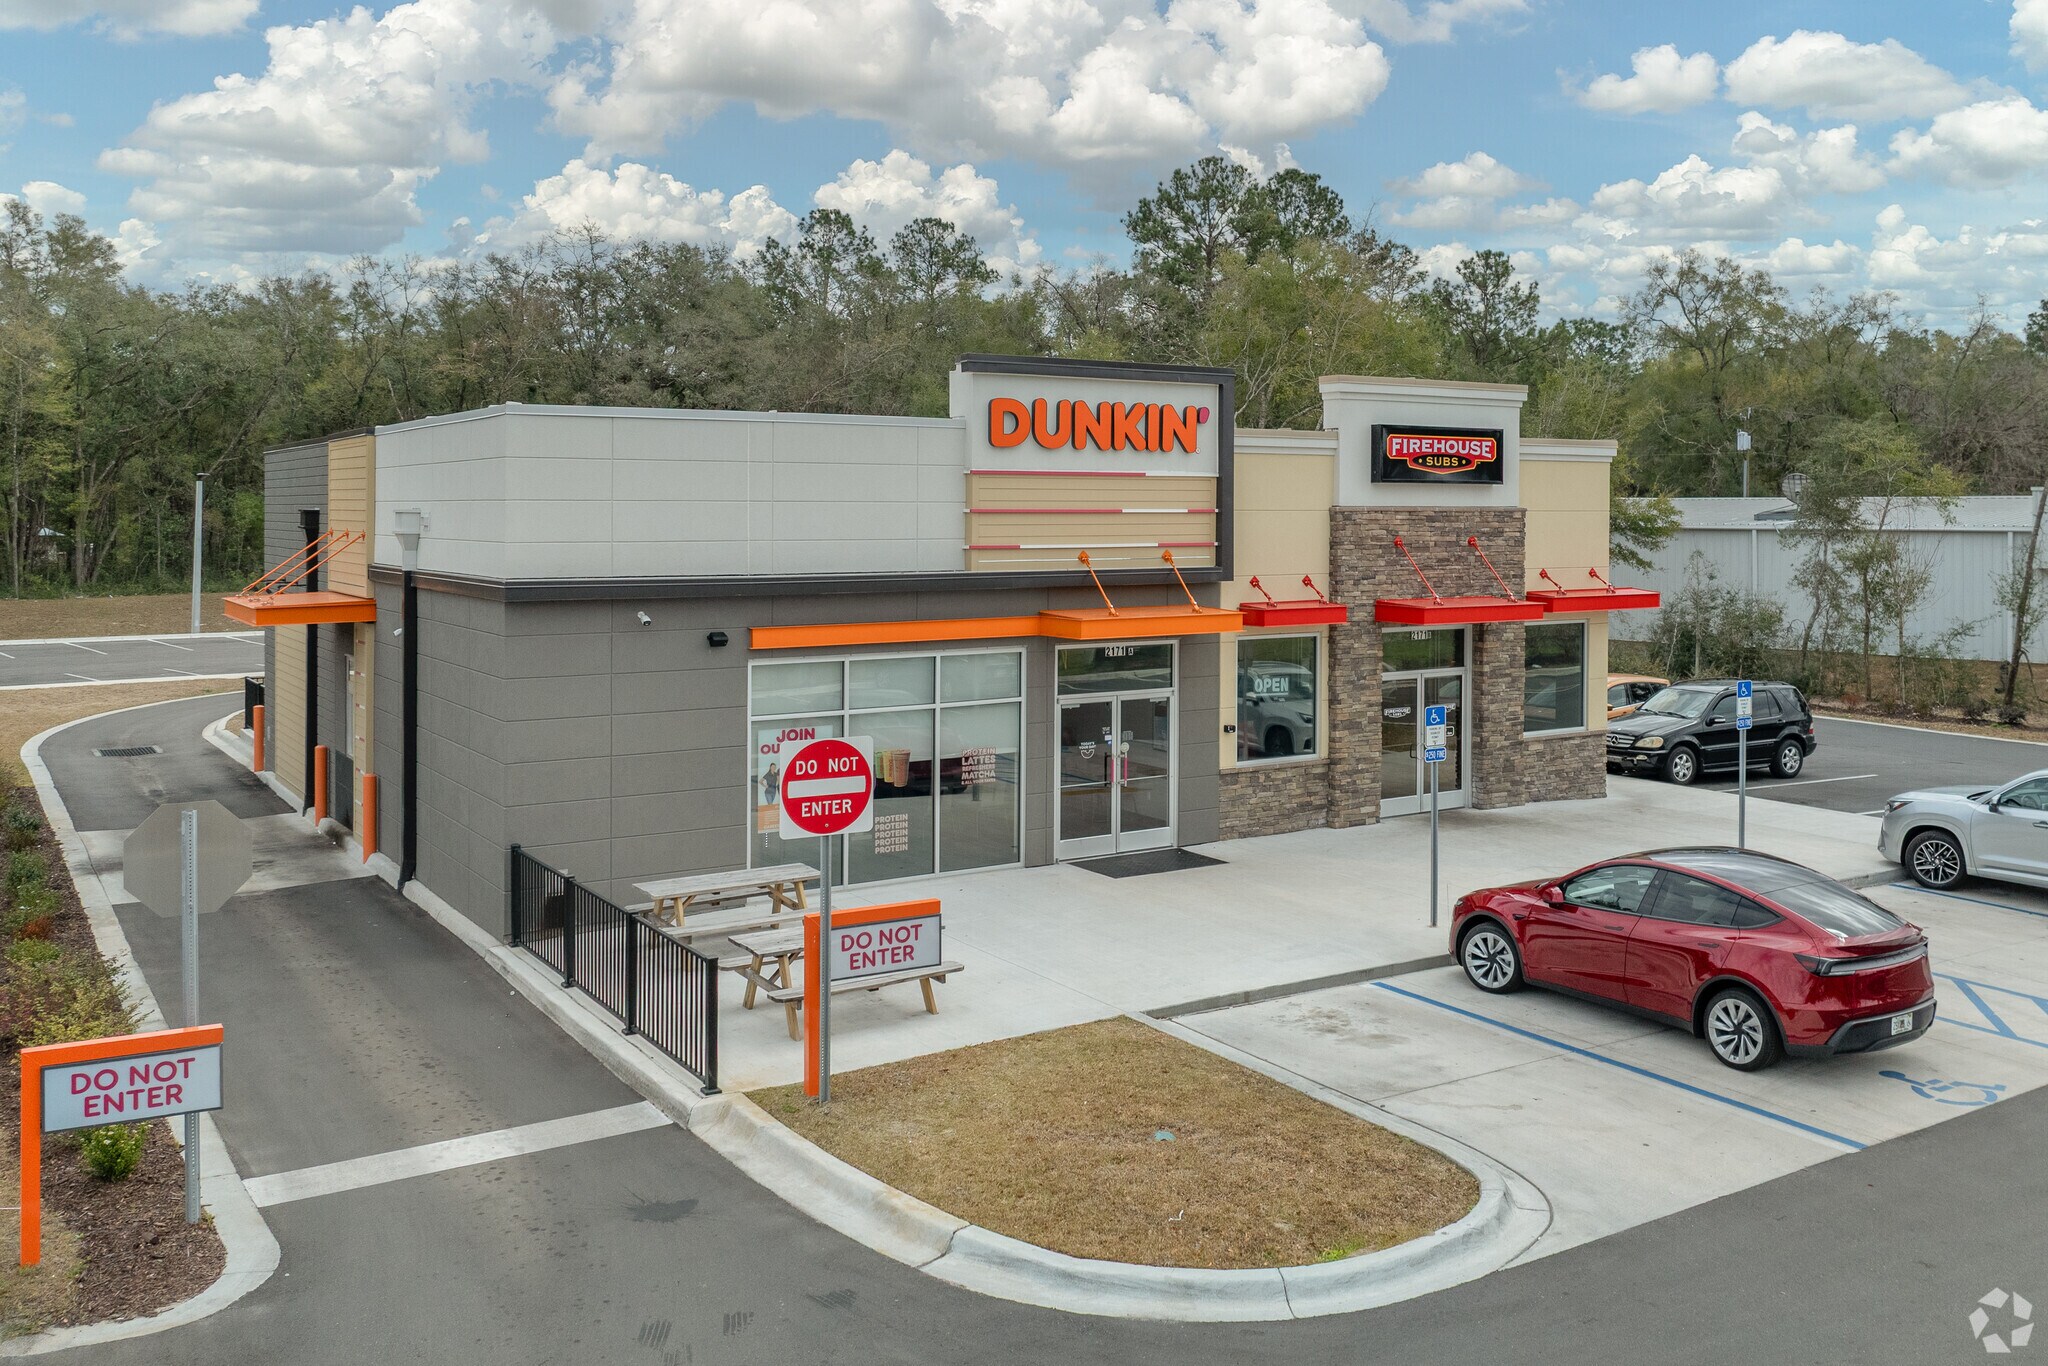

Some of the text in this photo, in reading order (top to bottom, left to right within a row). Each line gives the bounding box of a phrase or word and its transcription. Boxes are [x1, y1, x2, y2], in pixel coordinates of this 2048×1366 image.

[988, 398, 1210, 453] DUNKIN'
[1391, 438, 1492, 458] FIREHOUSE
[1426, 456, 1459, 466] SUBS
[1104, 646, 1126, 657] 2171
[1254, 677, 1289, 693] OPEN
[776, 728, 815, 743] JOIN
[760, 744, 781, 755] OU
[962, 748, 996, 757] PROTEIN
[961, 755, 996, 765] LATTES
[796, 756, 859, 776] DO NOT
[961, 770, 996, 780] MATCHA
[801, 799, 852, 818] ENTER
[875, 813, 908, 824] PROTEIN
[875, 821, 908, 832] PROTEIN
[875, 829, 908, 839] PROTEIN
[875, 836, 908, 847] PROTEIN
[875, 844, 908, 854] PROTEIN
[841, 924, 923, 953] DO NOT
[849, 945, 914, 971] ENTER
[71, 1057, 196, 1095] DO NOT
[84, 1084, 183, 1118] ENTER
